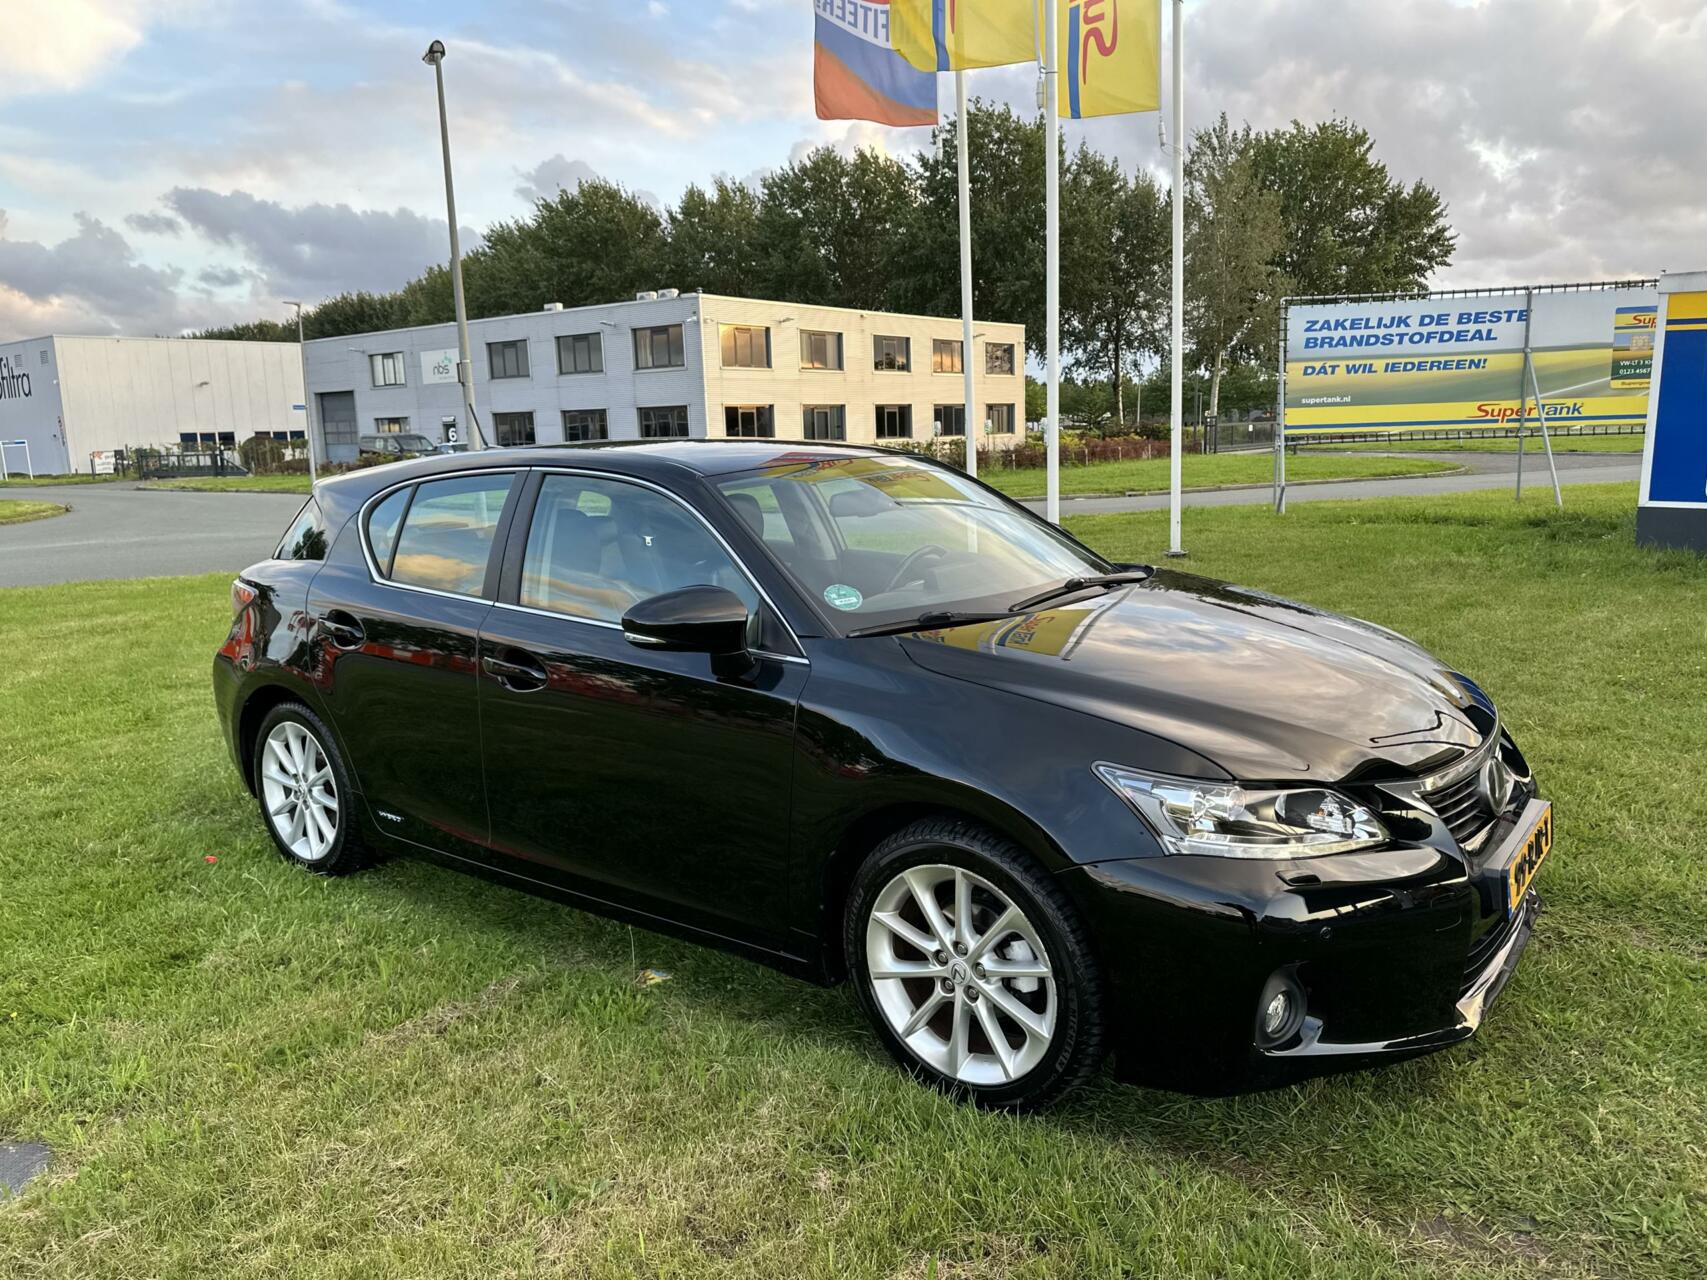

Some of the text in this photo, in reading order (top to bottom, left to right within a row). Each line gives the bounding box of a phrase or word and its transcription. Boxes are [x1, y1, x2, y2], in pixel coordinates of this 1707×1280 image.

[1304, 309, 1529, 332] ZAKELIJK DE BESTE
[1304, 329, 1497, 349] BRANDSTOFDEAL
[433, 362, 450, 375] nbs
[1302, 358, 1488, 376] DÁT WIL IEDEREEN!
[1301, 395, 1351, 405] supertank.nl
[448, 427, 457, 441] 6
